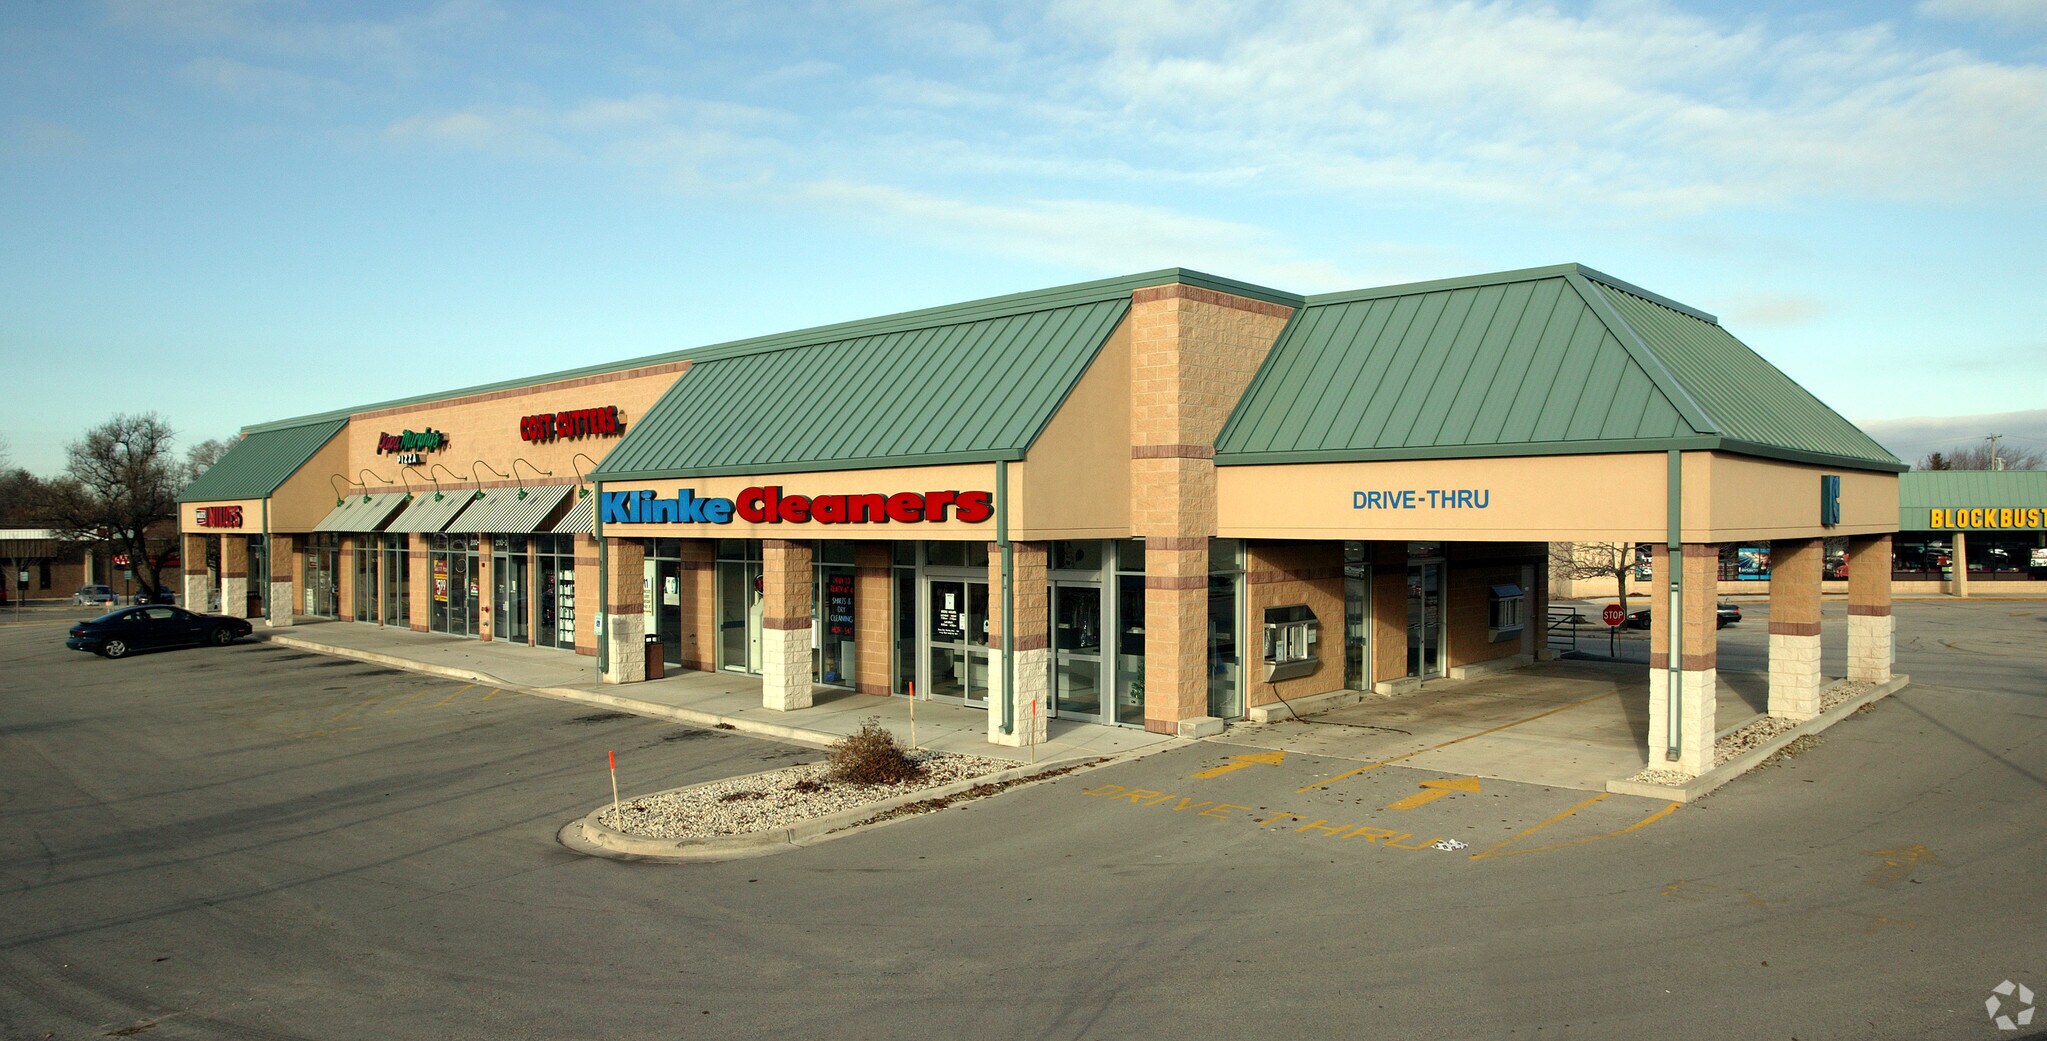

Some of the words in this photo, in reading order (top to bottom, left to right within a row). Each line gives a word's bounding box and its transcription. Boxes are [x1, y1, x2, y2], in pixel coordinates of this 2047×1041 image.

[520, 413, 555, 441] COST
[556, 405, 618, 438] CUTTERS
[397, 454, 417, 464] PIZZA
[602, 488, 735, 523] Klinke
[736, 486, 994, 523] Cleaners
[1353, 489, 1489, 509] DRIVE-THRU
[832, 597, 846, 605] SHIRTS
[830, 614, 853, 623] CLEANING
[1603, 611, 1623, 619] STOP
[1081, 784, 1252, 820] DRIVE
[1260, 811, 1443, 851] THRU
